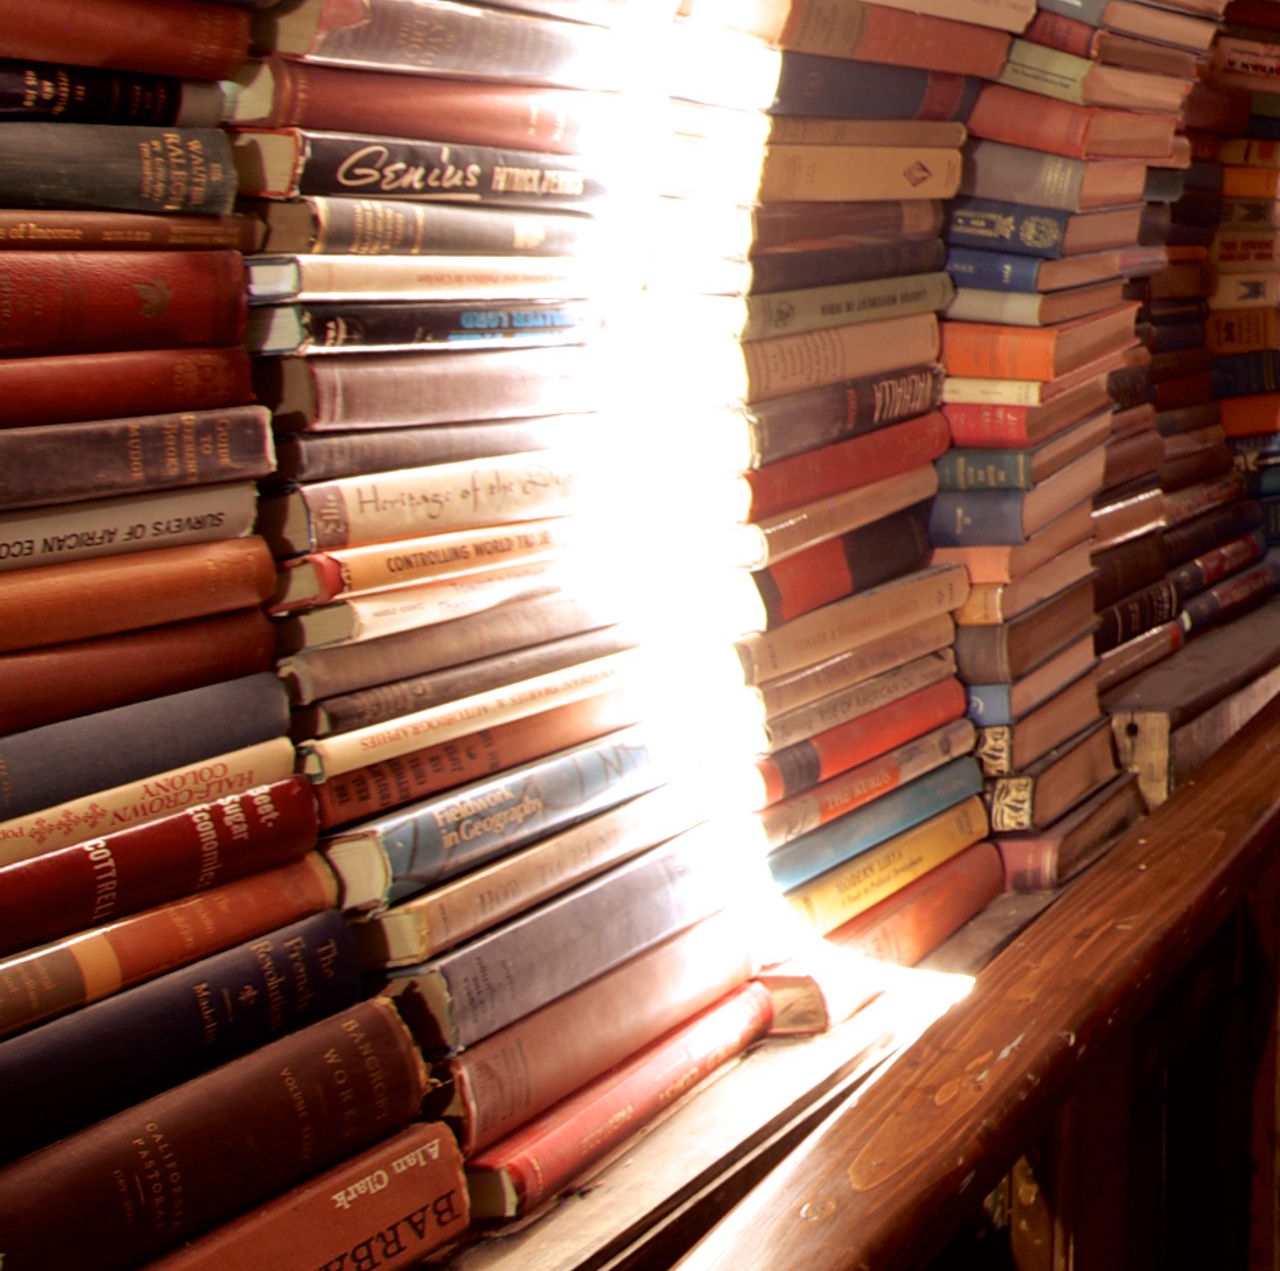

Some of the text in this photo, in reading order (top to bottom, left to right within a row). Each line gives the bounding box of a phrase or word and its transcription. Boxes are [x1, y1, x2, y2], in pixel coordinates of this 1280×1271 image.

[39, 79, 55, 100] AND
[182, 138, 209, 205] WALTER
[207, 162, 224, 182] SIR
[9, 222, 82, 240] of Income
[460, 312, 508, 327] LORD
[161, 423, 180, 476] BOOKS
[199, 435, 212, 454] TO
[214, 418, 230, 466] GUIDE
[356, 477, 452, 525] Heritage
[458, 471, 483, 511] of
[487, 469, 513, 496] the
[41, 507, 225, 556] SURVEYS OF AFRICAN
[386, 536, 514, 573] CONTROLLING WORLD
[362, 704, 488, 750] AUTOBIOGRAPHIES
[109, 770, 252, 825] HALF-CROWN
[140, 762, 227, 797] COLONY
[823, 788, 847, 808] THE
[215, 792, 252, 842] Sugar
[245, 784, 276, 829] Beet-
[434, 786, 511, 823] Fieldwork
[441, 828, 458, 847] in
[459, 798, 543, 841] Geography
[186, 804, 222, 889] Economics
[246, 940, 296, 1023] Revolution
[279, 938, 321, 1006] French
[314, 940, 344, 980] The
[278, 1067, 310, 1118] VOLUME
[310, 1051, 368, 1135] WORKS
[120, 1139, 177, 1226] PASTORAL
[131, 1124, 198, 1226] CALIFORNIA
[331, 1139, 446, 1211] Alan Clark
